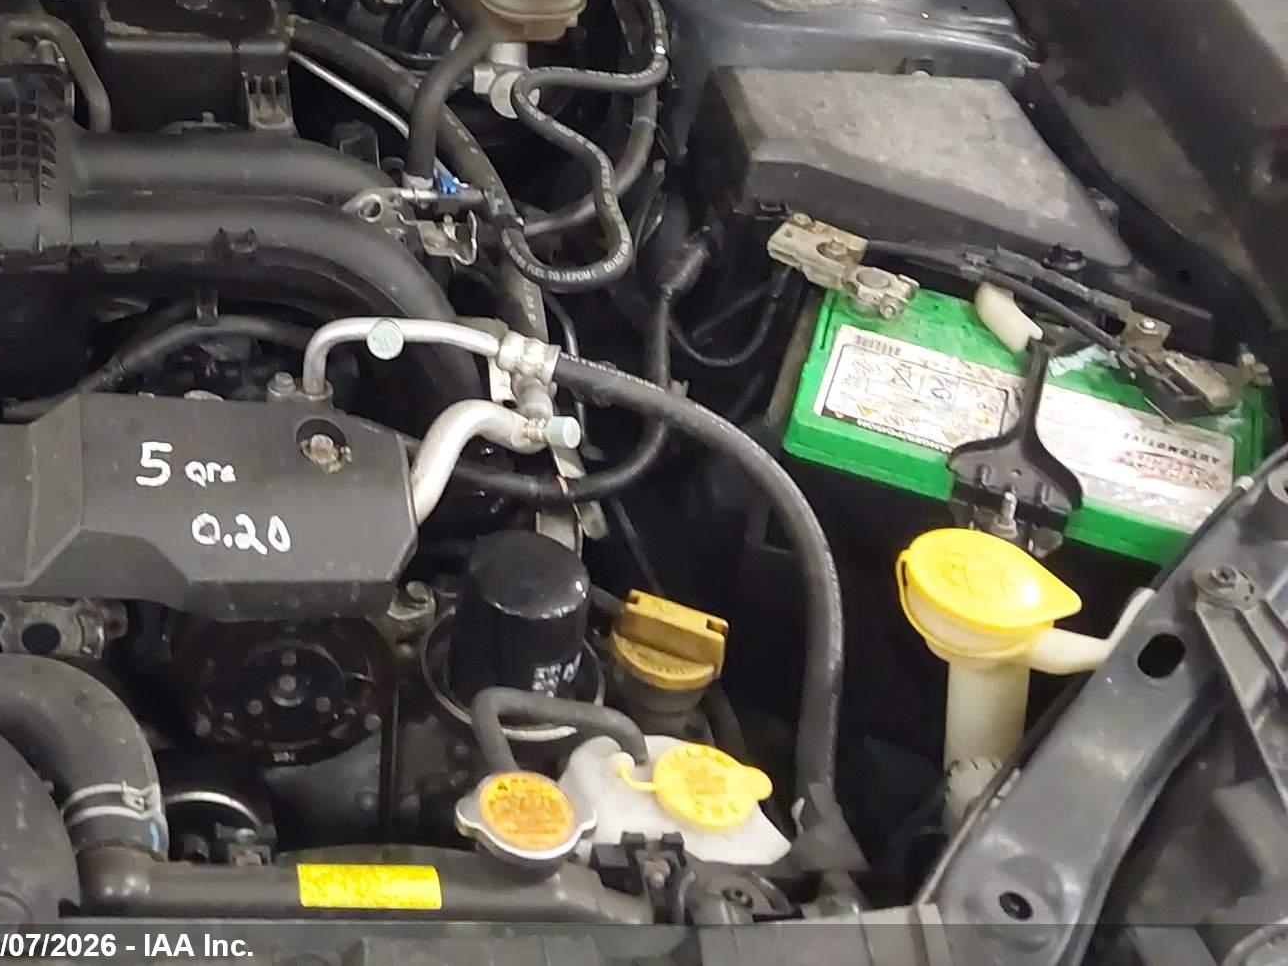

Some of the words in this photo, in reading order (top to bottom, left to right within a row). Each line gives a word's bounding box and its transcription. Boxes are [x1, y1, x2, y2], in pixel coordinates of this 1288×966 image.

[135, 441, 173, 487] 5
[1122, 430, 1221, 466] AUTOMOTIVE
[191, 512, 292, 556] 0.20
